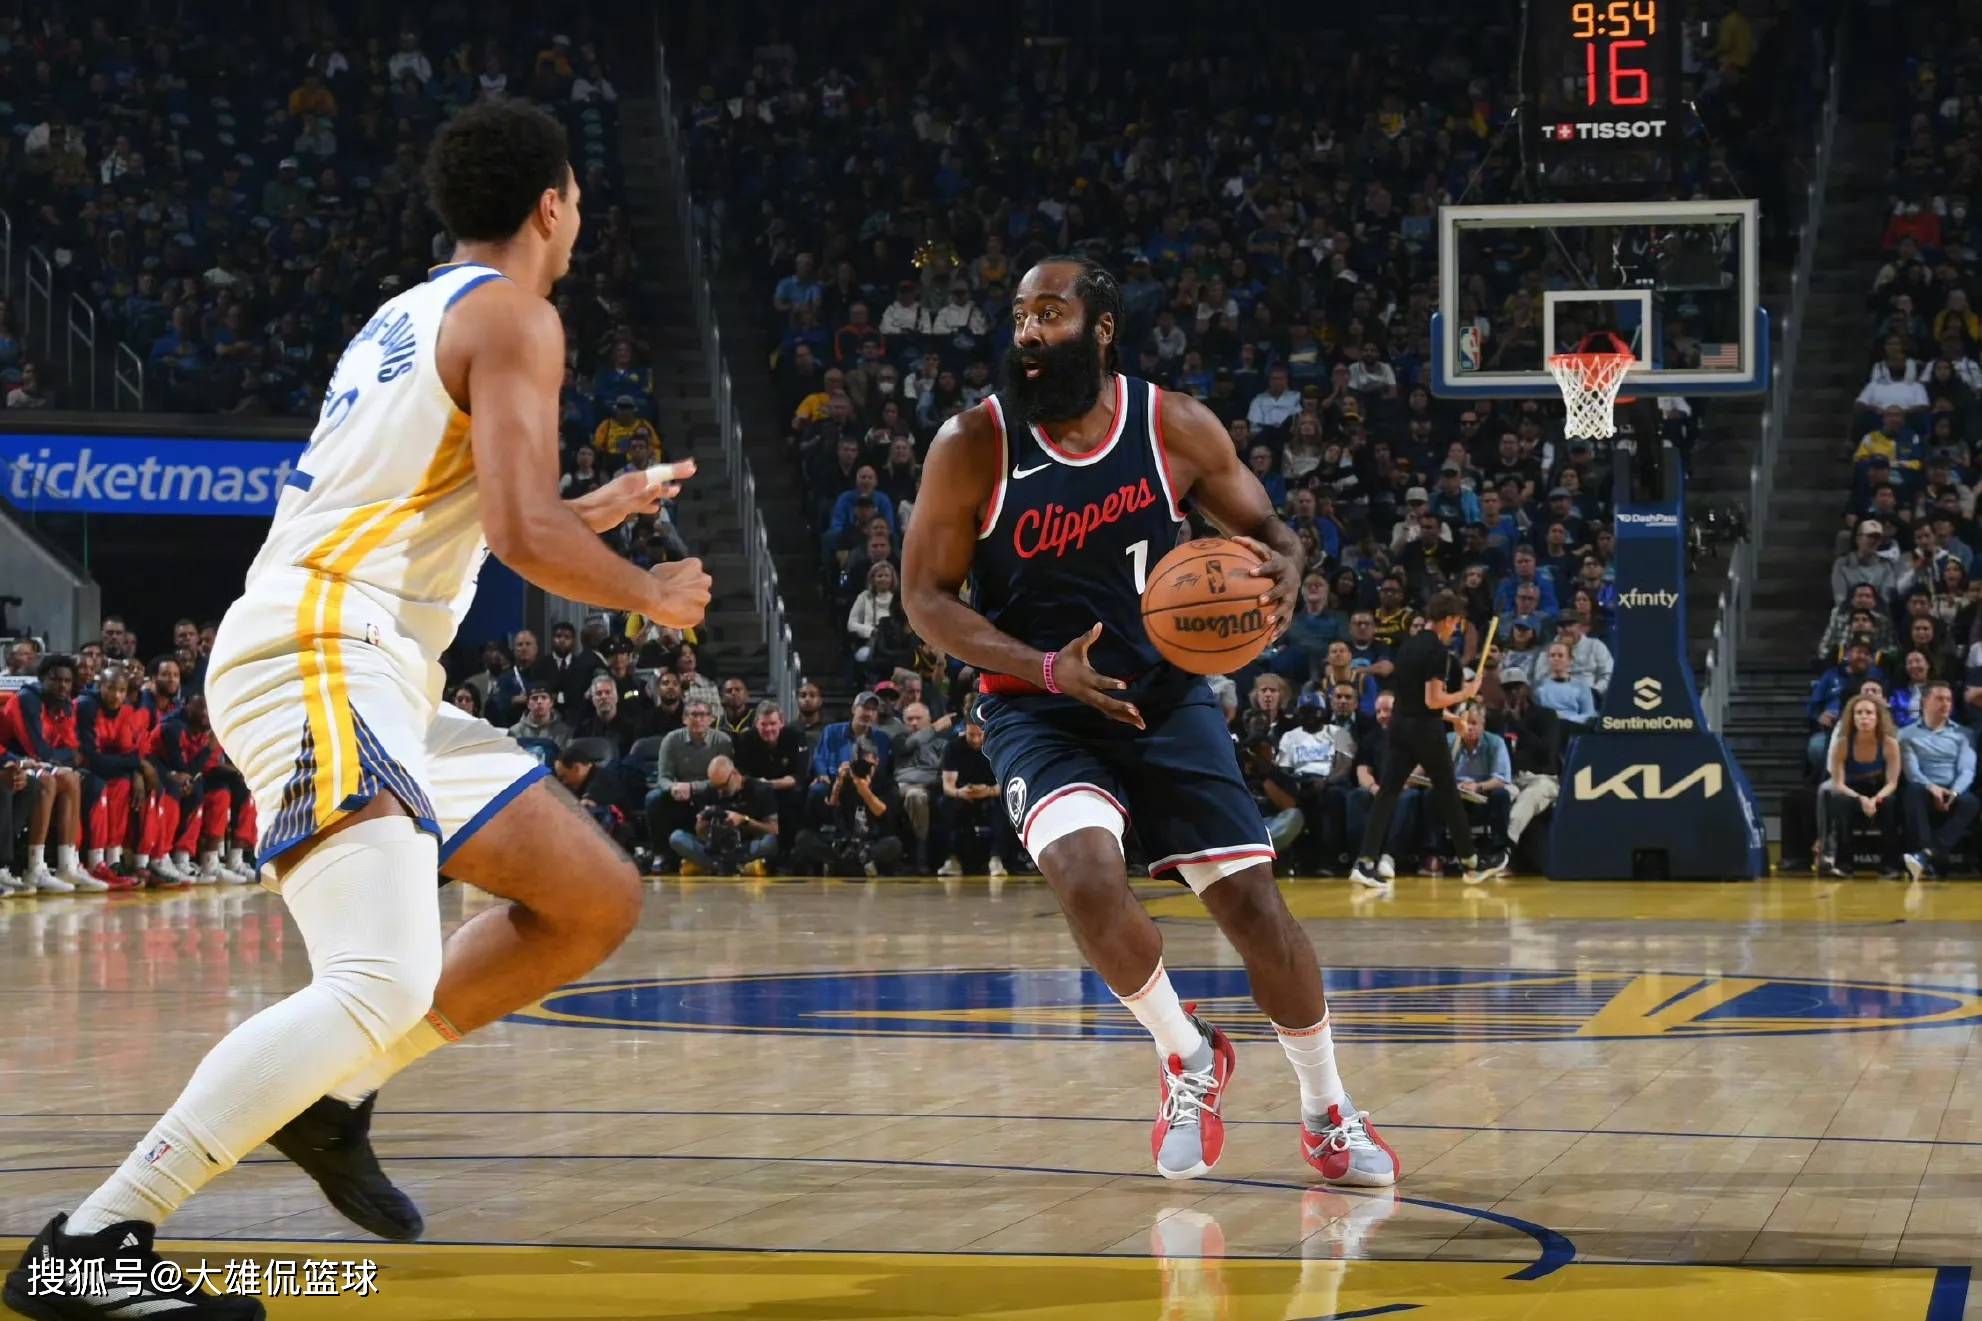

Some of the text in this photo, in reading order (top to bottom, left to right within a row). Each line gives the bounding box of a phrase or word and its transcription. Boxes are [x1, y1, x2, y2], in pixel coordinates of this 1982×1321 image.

[1572, 1, 1656, 37] 9:54
[1586, 40, 1648, 106] 16
[1576, 120, 1667, 139] TISSOT
[1013, 477, 1157, 558] Clippers
[1125, 539, 1149, 595] 1
[1618, 587, 1679, 608] xfinity
[1173, 608, 1264, 639] Wilson
[1602, 716, 1693, 730] SentinelOne
[1574, 763, 1722, 800] KIA
